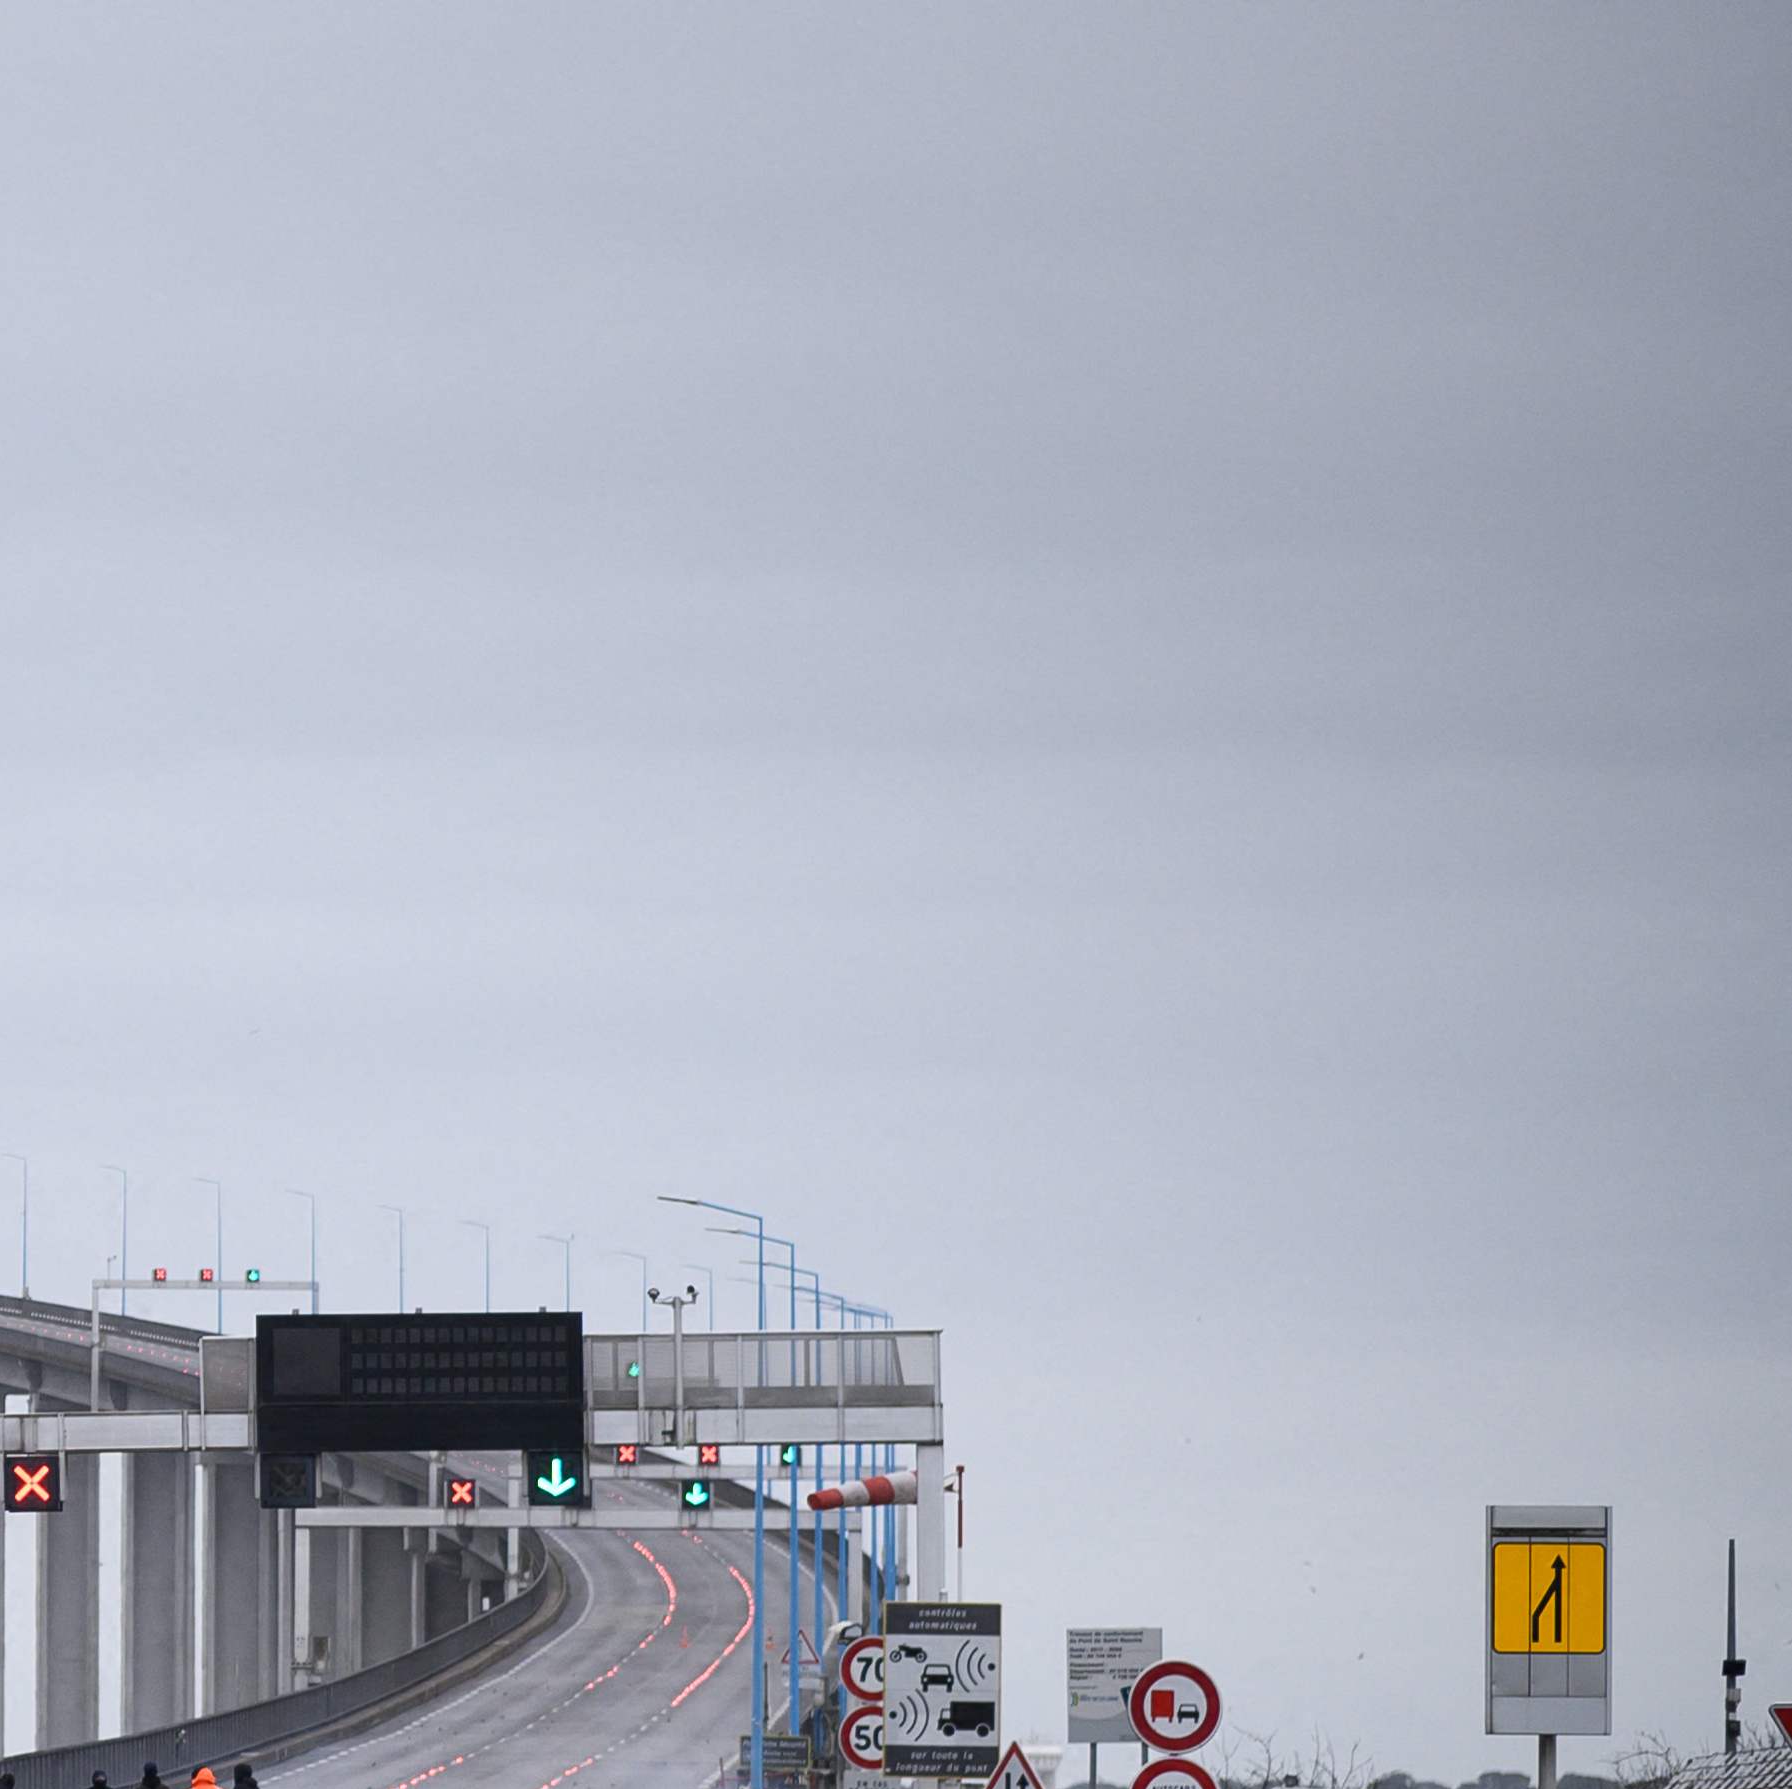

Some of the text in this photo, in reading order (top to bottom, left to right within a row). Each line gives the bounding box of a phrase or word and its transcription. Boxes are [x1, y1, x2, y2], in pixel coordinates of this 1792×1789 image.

[918, 1608, 967, 1617] contrôles
[909, 1620, 977, 1631] automatiques
[911, 1752, 926, 1760] sur
[932, 1752, 958, 1760] toute
[946, 1764, 959, 1772] du
[966, 1765, 988, 1774] pont
